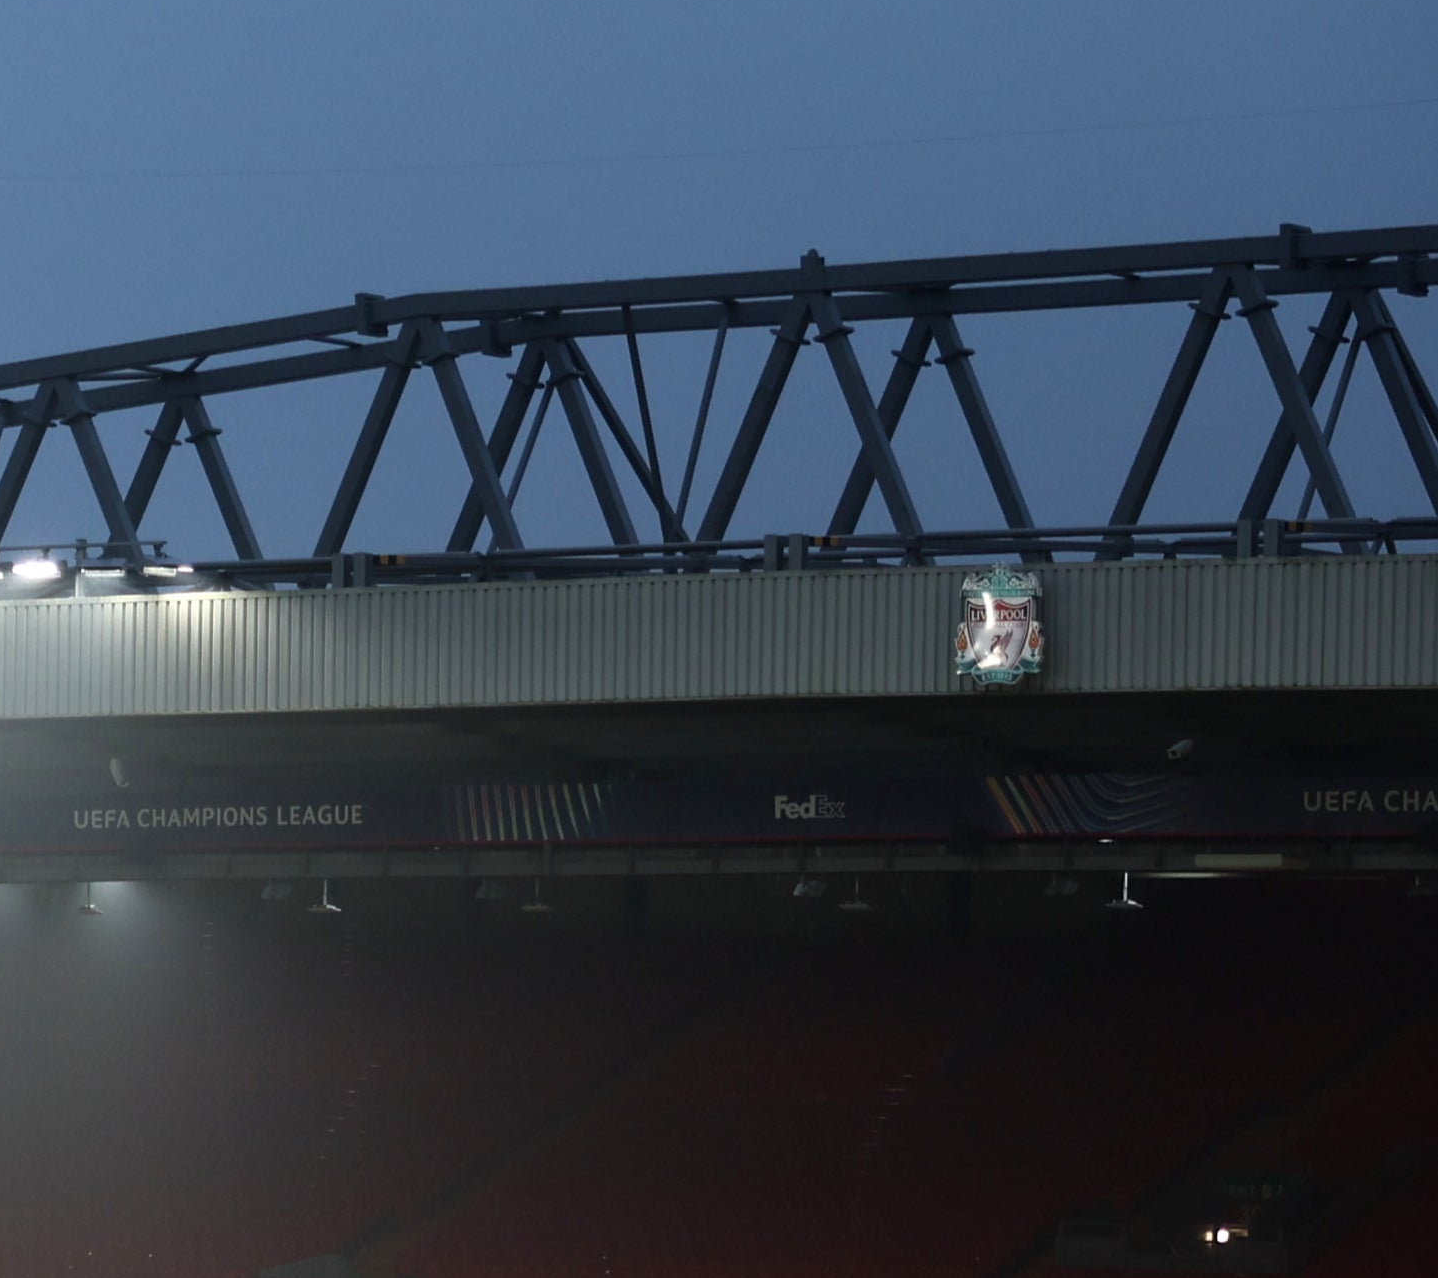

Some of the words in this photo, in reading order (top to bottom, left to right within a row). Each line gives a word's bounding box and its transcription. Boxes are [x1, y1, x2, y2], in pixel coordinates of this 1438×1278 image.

[971, 609, 1027, 621] LIVRPOOL
[774, 794, 845, 820] FedEx
[1303, 790, 1375, 812] UEFA
[73, 808, 131, 830] UEFA
[137, 806, 269, 828] CHAMPIONS
[277, 804, 363, 826] LEAGUE
